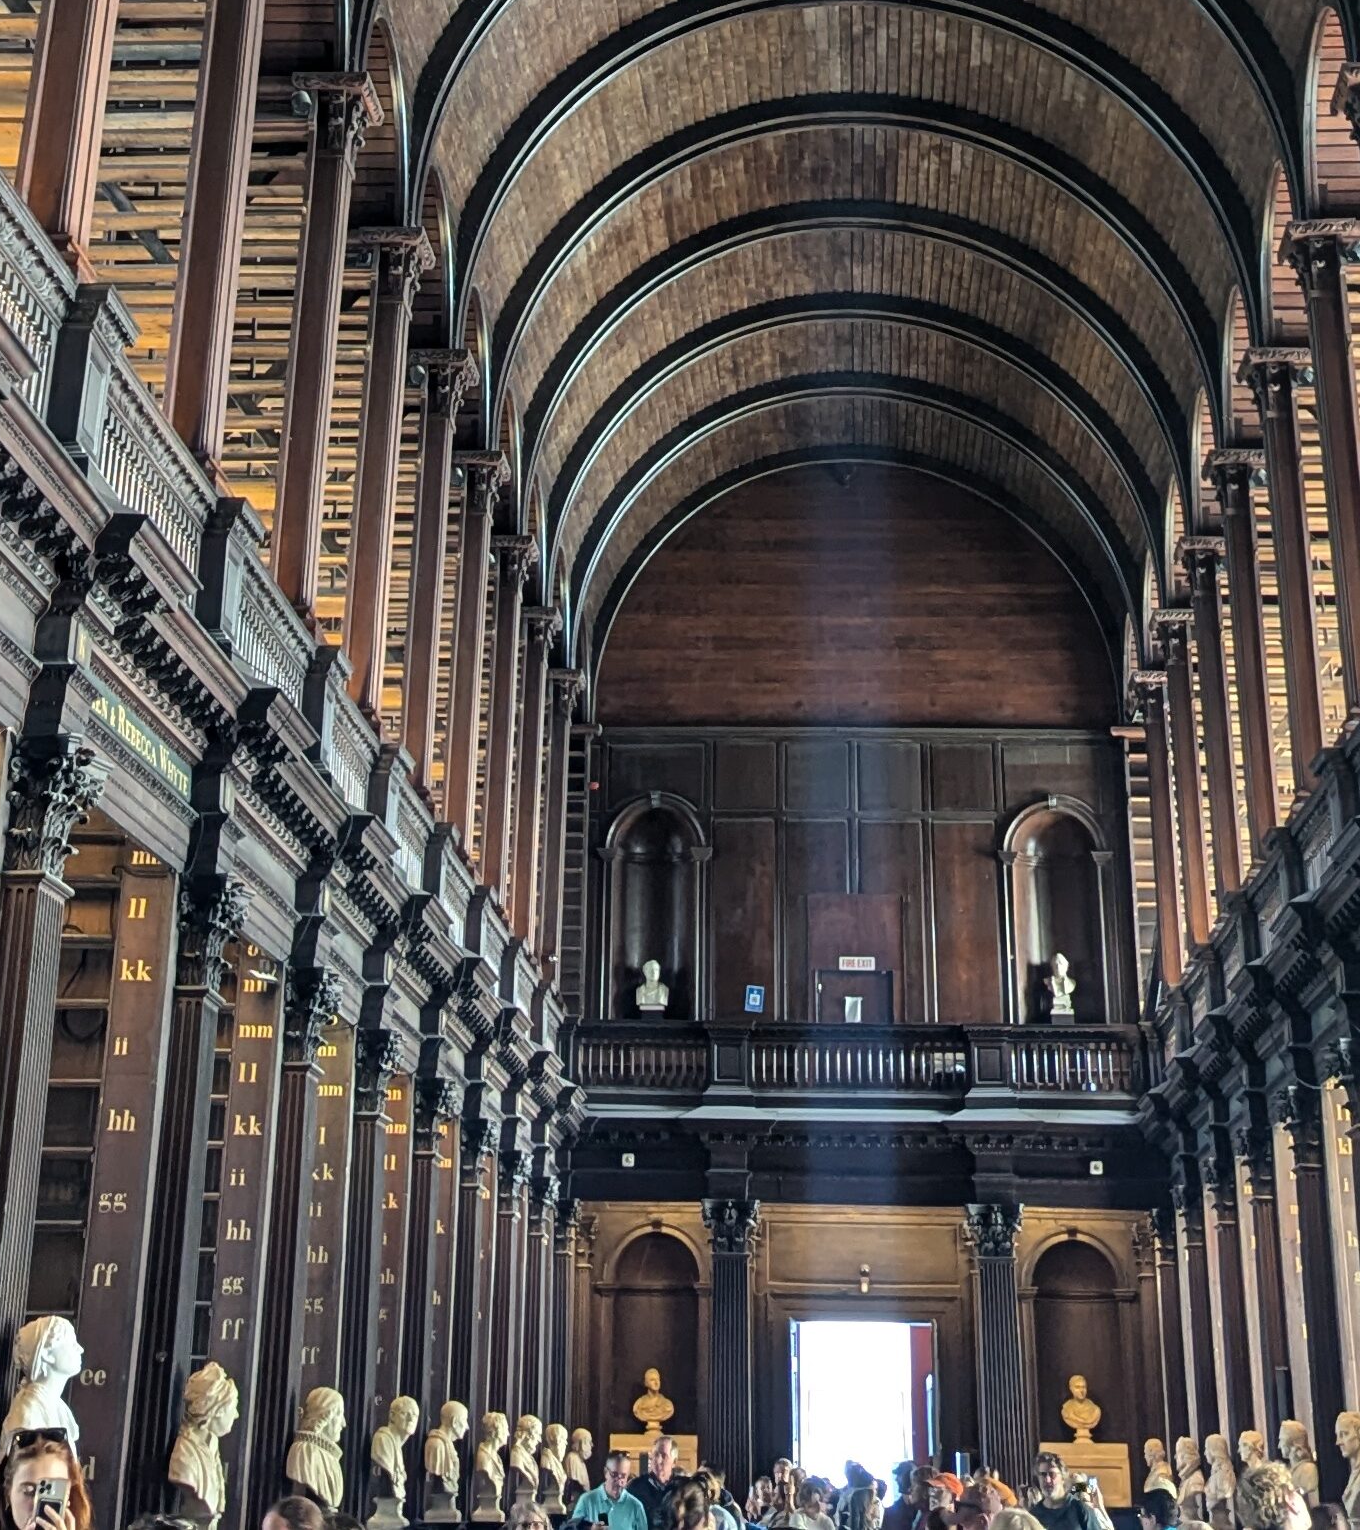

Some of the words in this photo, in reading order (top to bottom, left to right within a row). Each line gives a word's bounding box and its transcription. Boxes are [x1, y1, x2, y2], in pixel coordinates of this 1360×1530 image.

[117, 703, 158, 768] REBECCA
[159, 744, 190, 797] WHYTE
[127, 897, 147, 919] ll
[120, 958, 153, 982] kk
[841, 958, 856, 968] FIRE
[857, 958, 873, 968] EXIT
[239, 1024, 274, 1039] mm
[113, 1036, 128, 1056] ii
[238, 1063, 258, 1083] ll
[106, 1109, 136, 1132] hh
[233, 1115, 263, 1136] kk
[229, 1168, 246, 1186] ii
[98, 1191, 127, 1213] gg
[225, 1220, 252, 1241] hh
[306, 1244, 329, 1264] hh
[91, 1262, 118, 1287] ff
[221, 1276, 245, 1294] gg
[220, 1318, 245, 1340] ff
[300, 1346, 321, 1365] ff
[80, 1368, 107, 1386] ee
